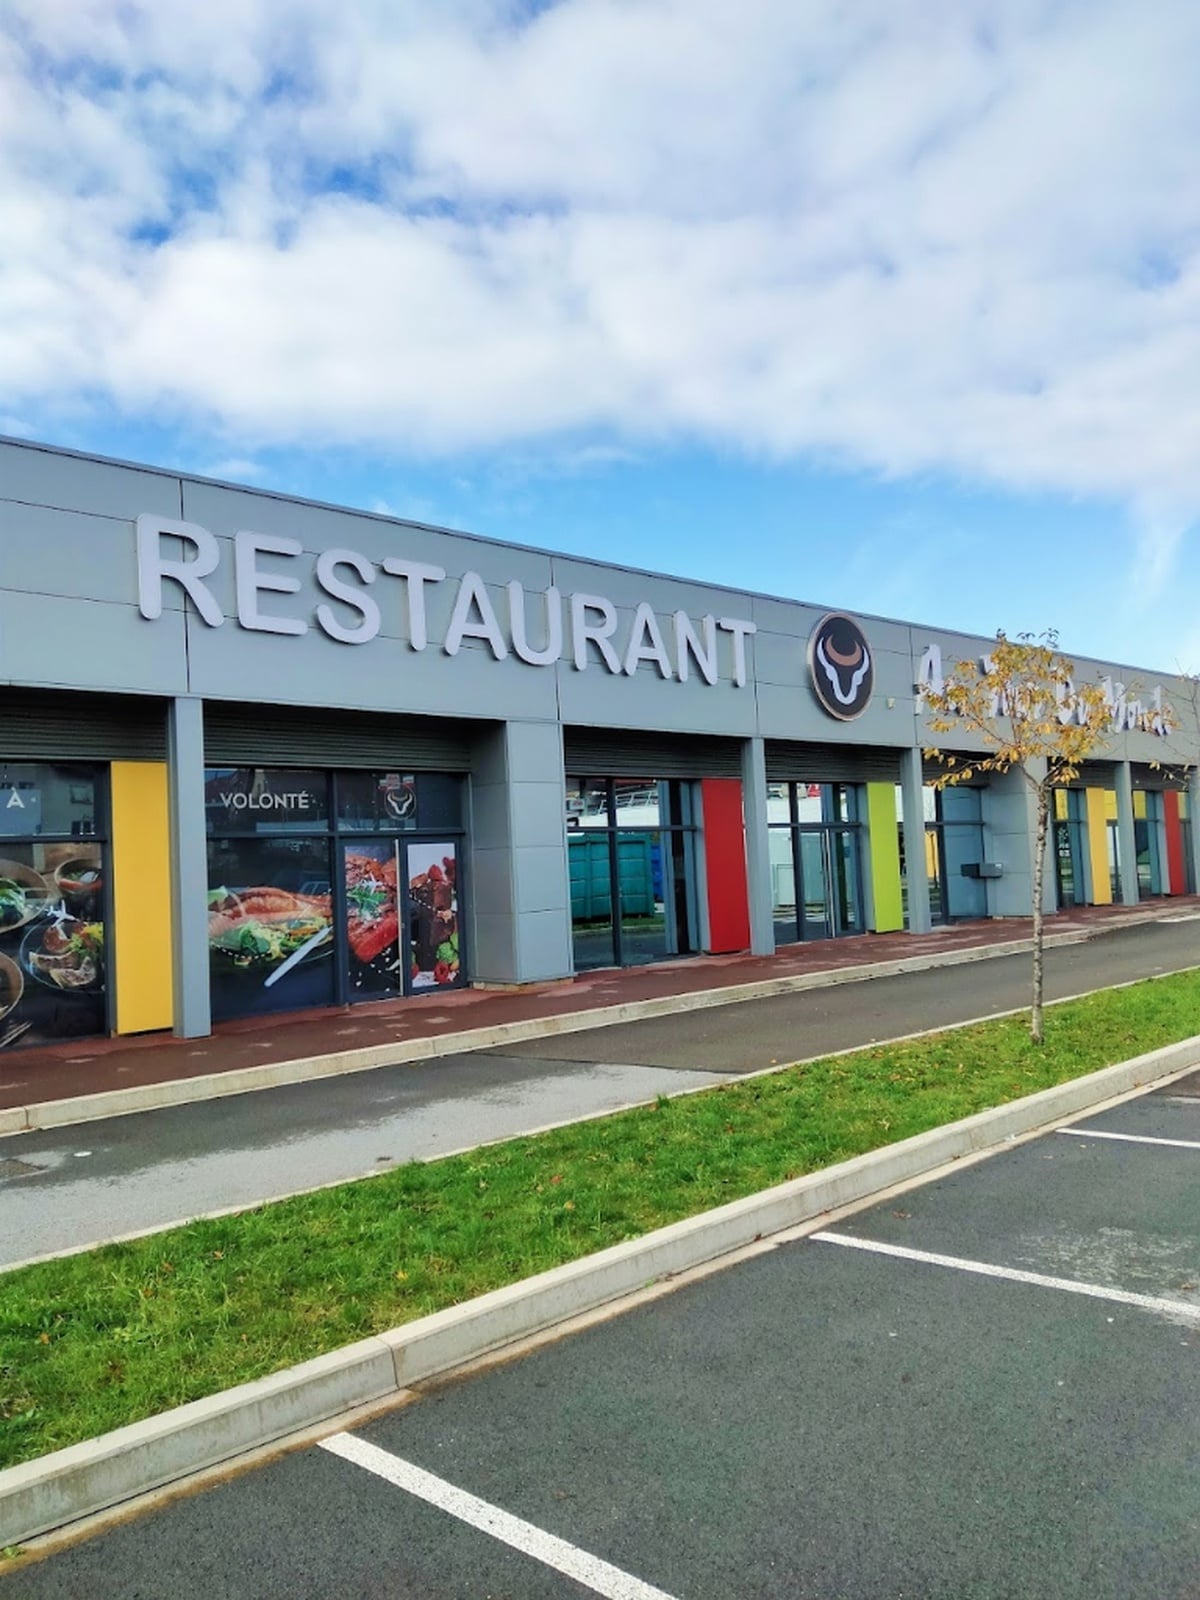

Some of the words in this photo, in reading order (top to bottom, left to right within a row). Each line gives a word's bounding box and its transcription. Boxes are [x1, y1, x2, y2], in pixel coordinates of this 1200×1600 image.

[136, 513, 757, 688] RESTAURANT
[6, 787, 25, 808] À
[219, 791, 309, 809] VOLONTÉ
